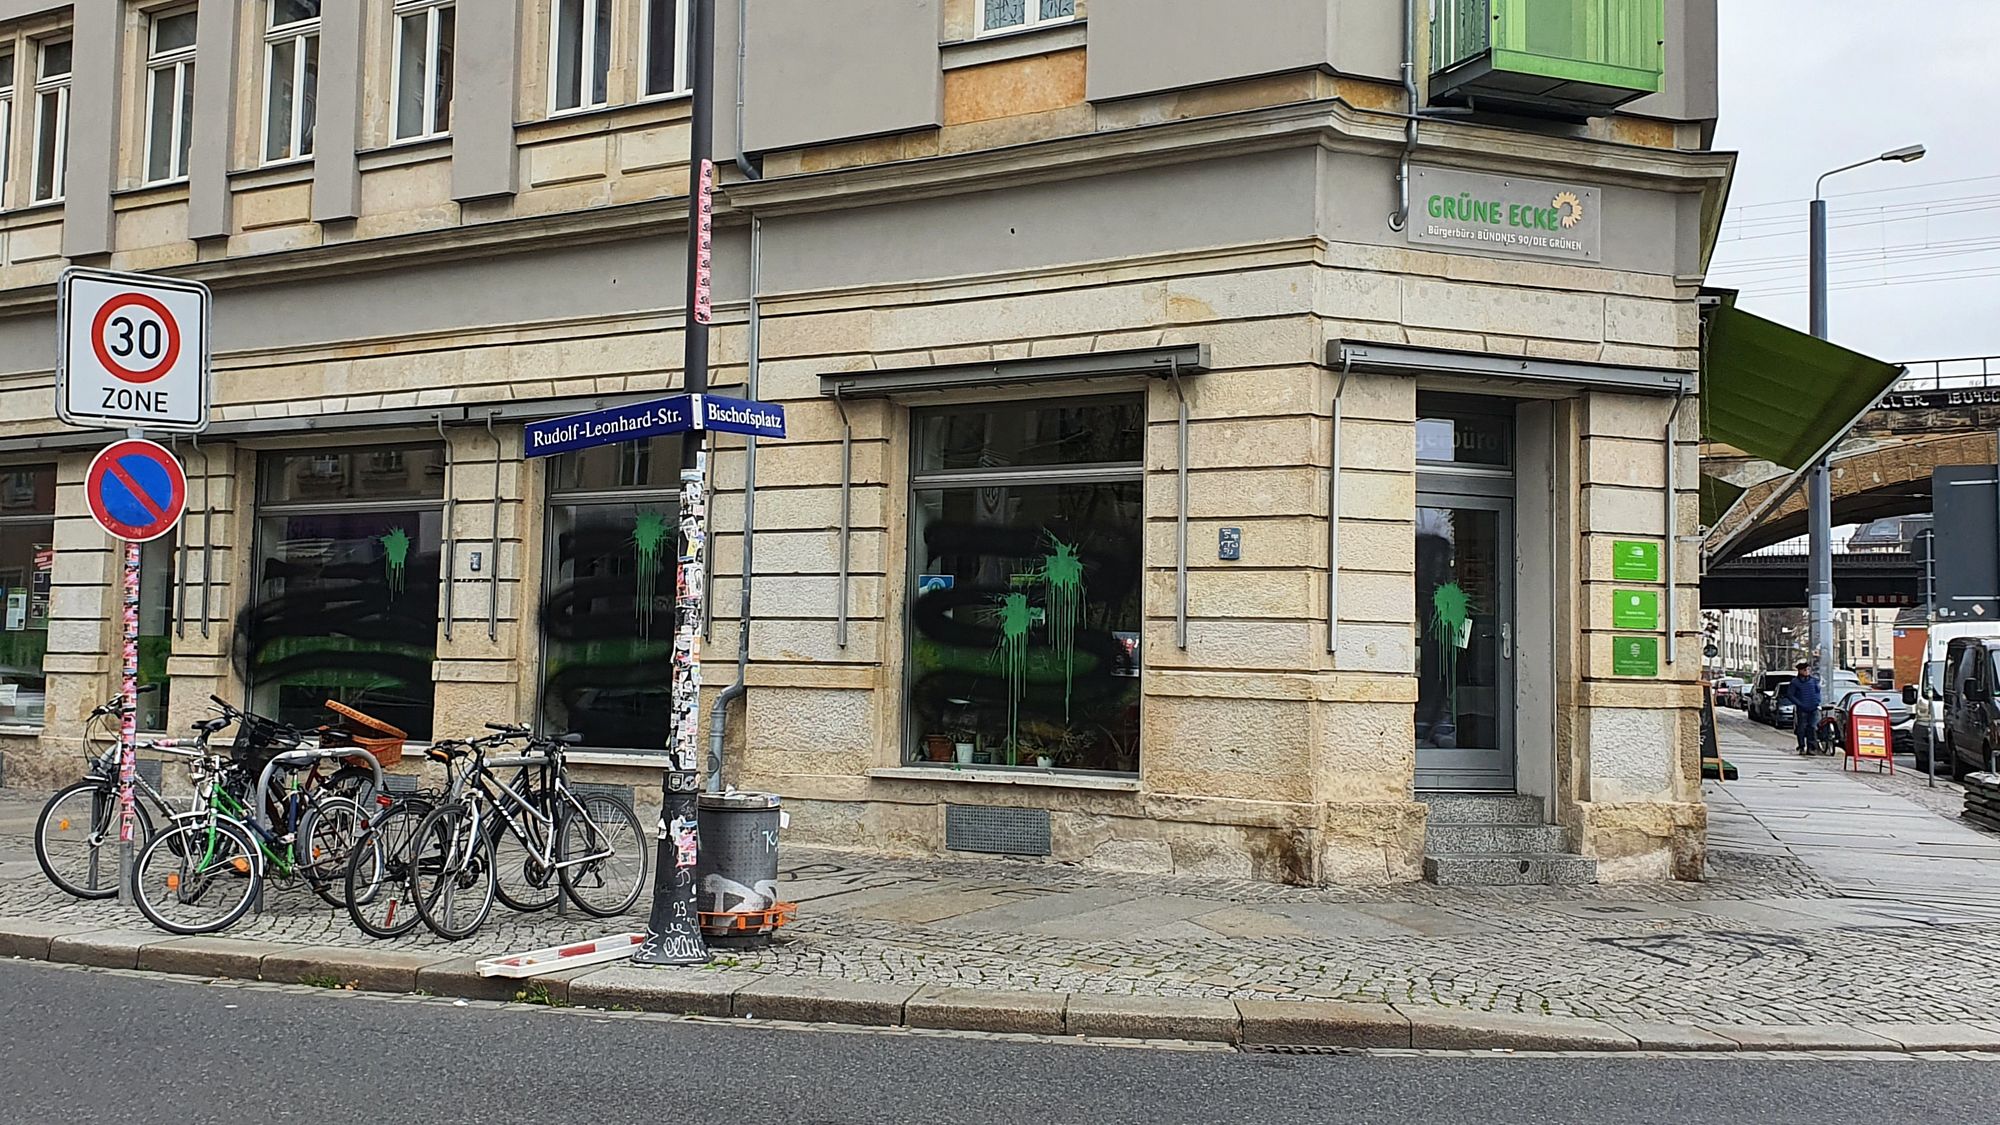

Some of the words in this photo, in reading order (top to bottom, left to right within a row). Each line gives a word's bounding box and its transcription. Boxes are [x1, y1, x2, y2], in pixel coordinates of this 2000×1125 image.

[1427, 193, 1501, 225] GRÜNE
[1509, 204, 1559, 232] ECKE
[1427, 225, 1475, 240] Bürgerbüro
[1477, 227, 1516, 244] BÜNDNIS
[1517, 234, 1548, 248] 90/DIE
[1549, 237, 1583, 251] GRÜNEN
[110, 316, 162, 360] 30
[101, 387, 169, 413] ZONE
[707, 402, 782, 429] Bischofsplatz
[533, 407, 683, 448] Rudolf-Leonhard-Str.
